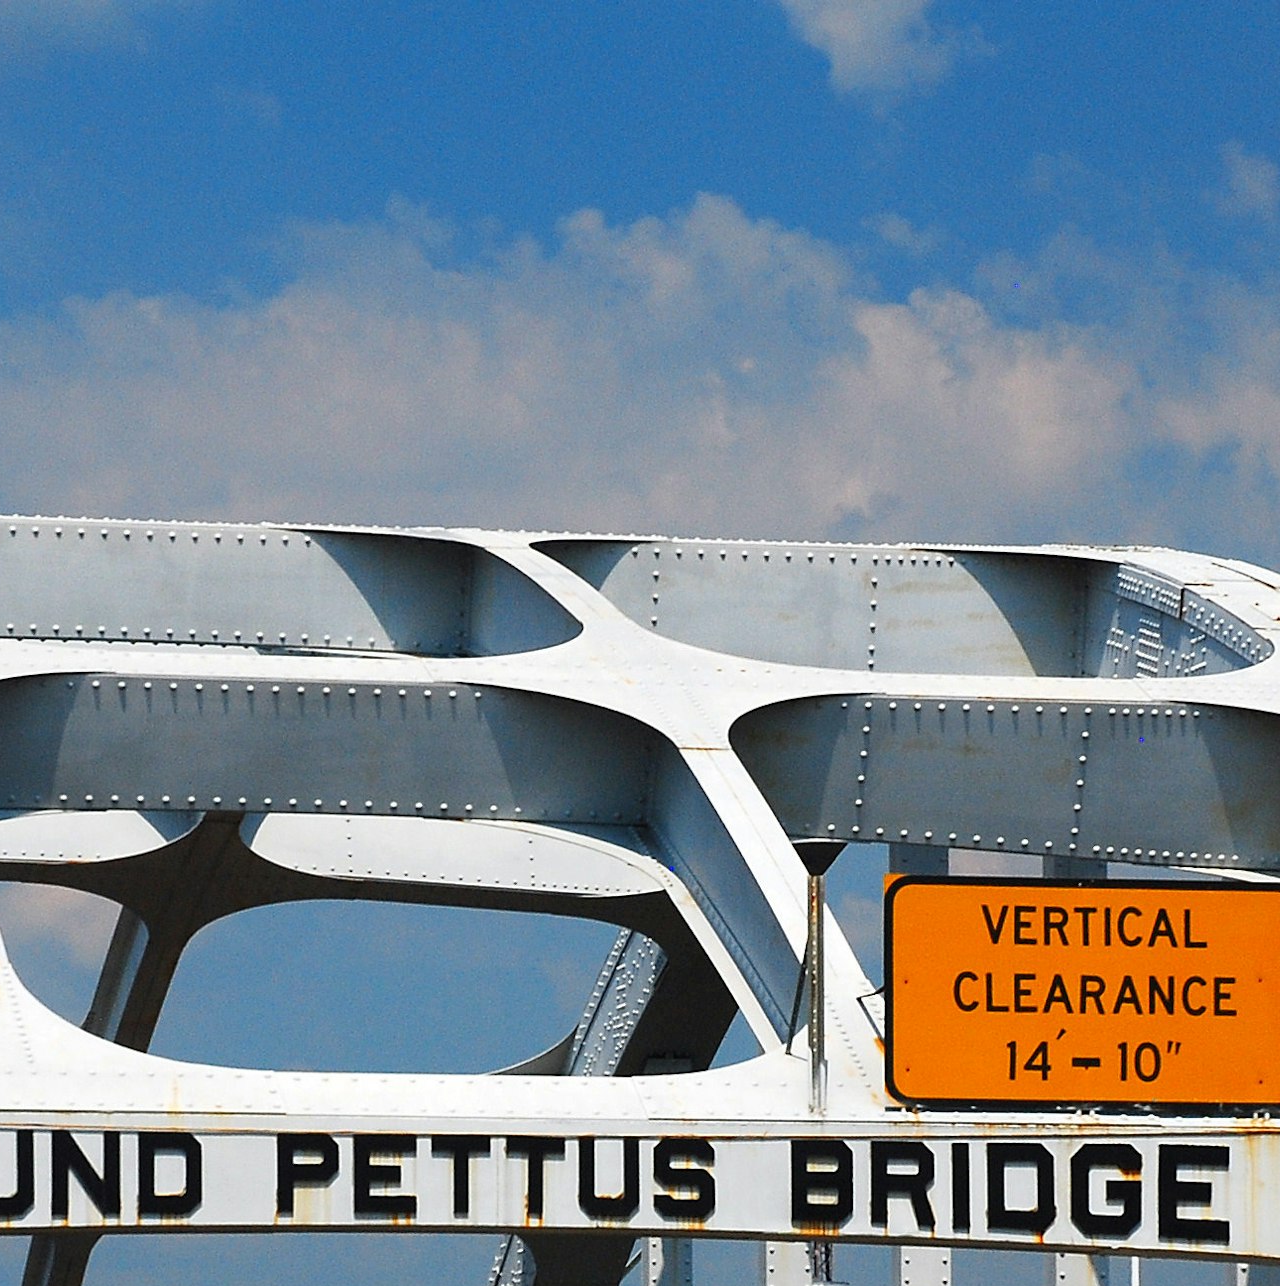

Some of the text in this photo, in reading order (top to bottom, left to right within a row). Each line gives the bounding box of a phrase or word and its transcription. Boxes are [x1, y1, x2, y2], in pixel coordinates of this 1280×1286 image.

[981, 904, 1208, 949] VERTICAL
[952, 971, 1238, 1017] CLEARANCE
[276, 1132, 716, 1226] PETTUS
[790, 1139, 1231, 1243] BRIDGE
